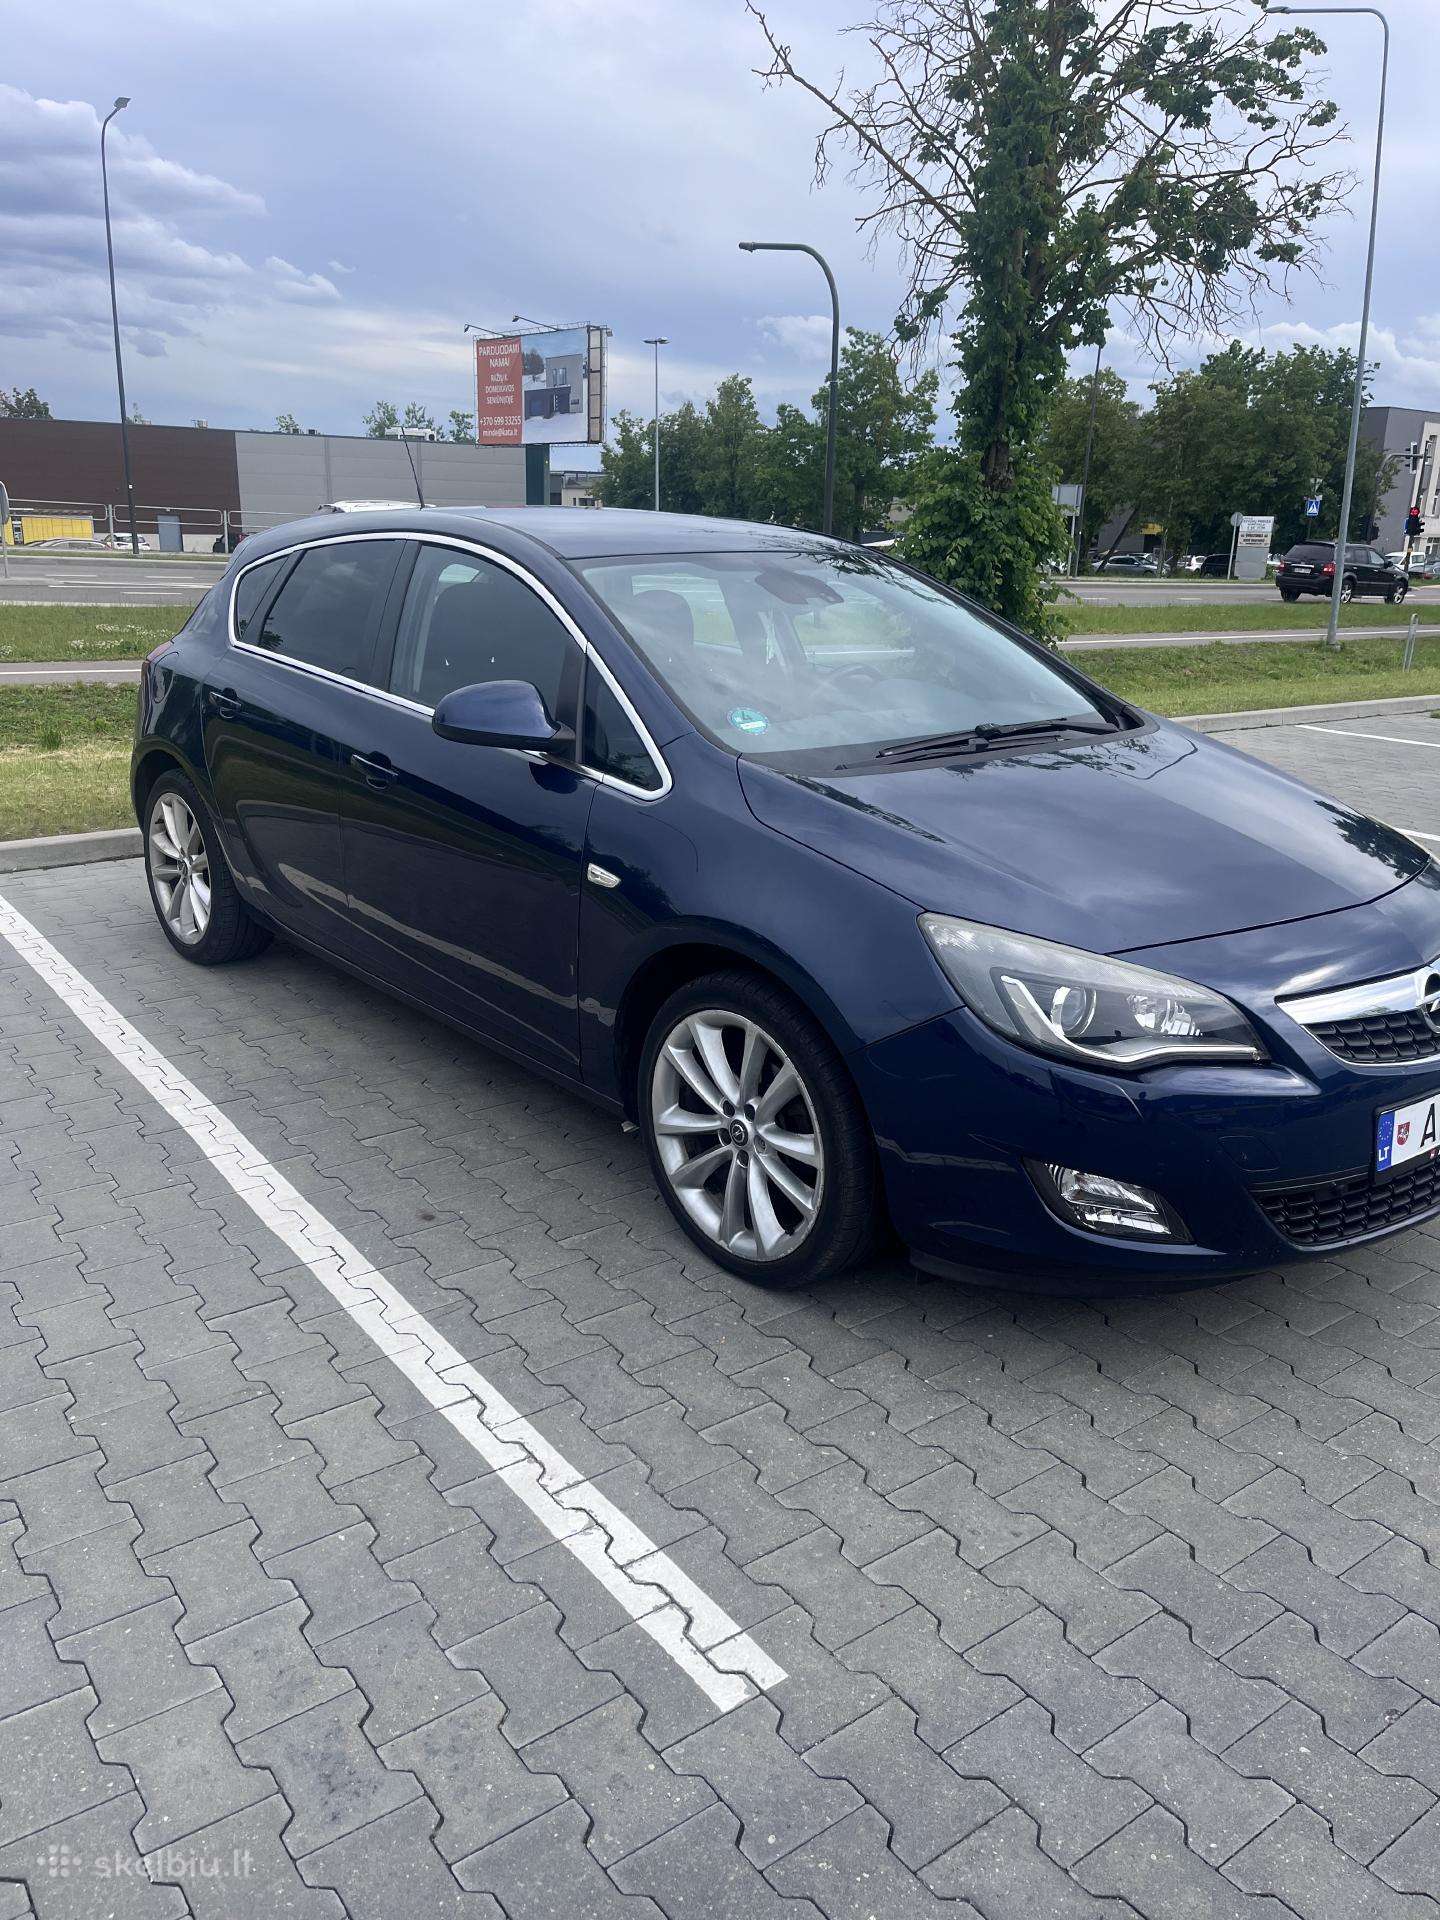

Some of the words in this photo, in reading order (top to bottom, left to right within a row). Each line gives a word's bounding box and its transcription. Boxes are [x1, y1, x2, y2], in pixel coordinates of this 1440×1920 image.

[479, 344, 520, 356] PARDUODAMI
[490, 357, 510, 368] NAMAI
[480, 417, 493, 426] +370
[505, 415, 521, 426] 33255
[1420, 1103, 1436, 1148] A
[1378, 1145, 1390, 1162] LT
